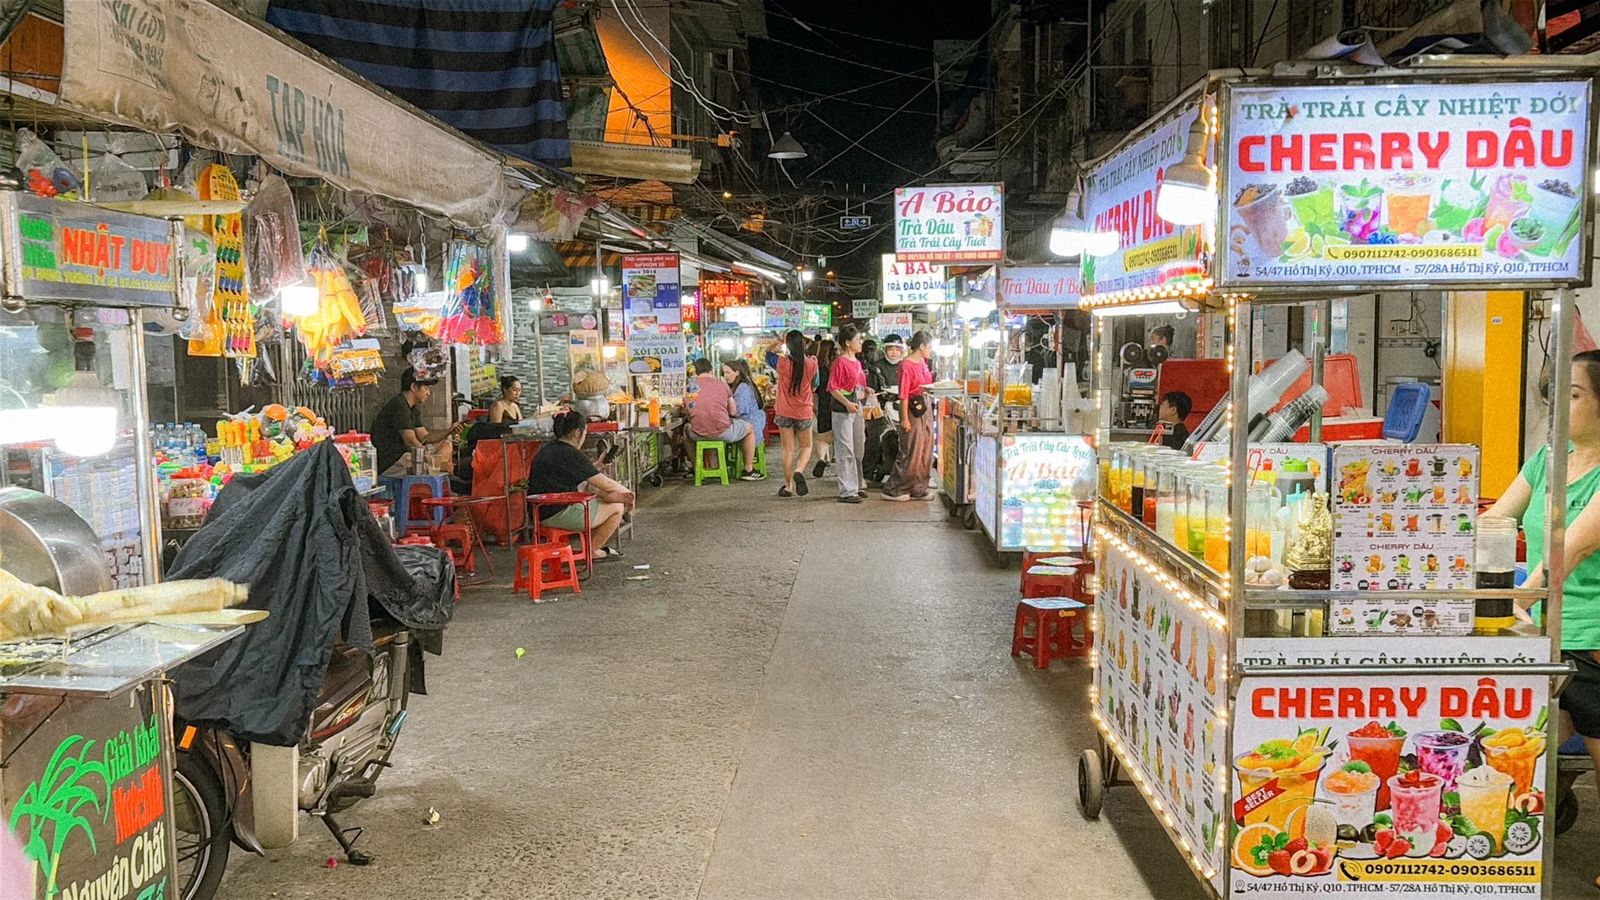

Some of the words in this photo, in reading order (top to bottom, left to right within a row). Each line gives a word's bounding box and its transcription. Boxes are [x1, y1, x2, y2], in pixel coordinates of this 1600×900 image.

[1241, 97, 1294, 120] TRÀ
[1302, 95, 1365, 118] TRÁI
[1374, 94, 1429, 116] CÂY
[1438, 92, 1521, 119] NHIỆT
[1530, 91, 1578, 114] ĐỚI
[1238, 131, 1450, 172] CHERRY
[1466, 117, 1574, 168] DÂU
[898, 191, 925, 217] A
[932, 189, 999, 214] Bảo
[898, 218, 923, 236] Trà
[925, 218, 956, 235] Dâu
[63, 223, 126, 279] NHẬT
[130, 239, 171, 277] DUY
[898, 237, 917, 249] Trà
[919, 236, 941, 248] Trái
[942, 236, 962, 250] Cây
[1343, 249, 1478, 259] 0907112742-0903686511
[1255, 266, 1282, 277] 54/47
[1284, 264, 1299, 276] Hồ
[1300, 264, 1316, 278] Thị
[1361, 265, 1401, 275] TPHCM
[1414, 263, 1448, 274] 57/28A
[1451, 262, 1466, 273] Hồ
[1467, 262, 1484, 276] Thị
[1529, 262, 1569, 272] TPHCM
[633, 346, 651, 356] XÔI
[653, 345, 679, 355] XOÀI
[1371, 447, 1414, 455] CHERRY
[1413, 541, 1435, 550] DÂU
[1251, 687, 1427, 718] CHERRY
[1440, 677, 1532, 719] DÂU
[1243, 789, 1276, 812] SELLER
[1244, 786, 1266, 804] BEST
[130, 820, 167, 889] Chất
[1364, 864, 1536, 876] 0907112742-0903686511
[1246, 883, 1272, 893] 54/47
[1274, 882, 1288, 892] Hồ
[1288, 883, 1305, 894] Thị
[1346, 883, 1383, 892] TPHCM
[1389, 884, 1422, 893] 57/28A
[1423, 883, 1438, 892] Hồ
[1440, 884, 1455, 894] Thị
[1499, 885, 1536, 894] TPHCM
